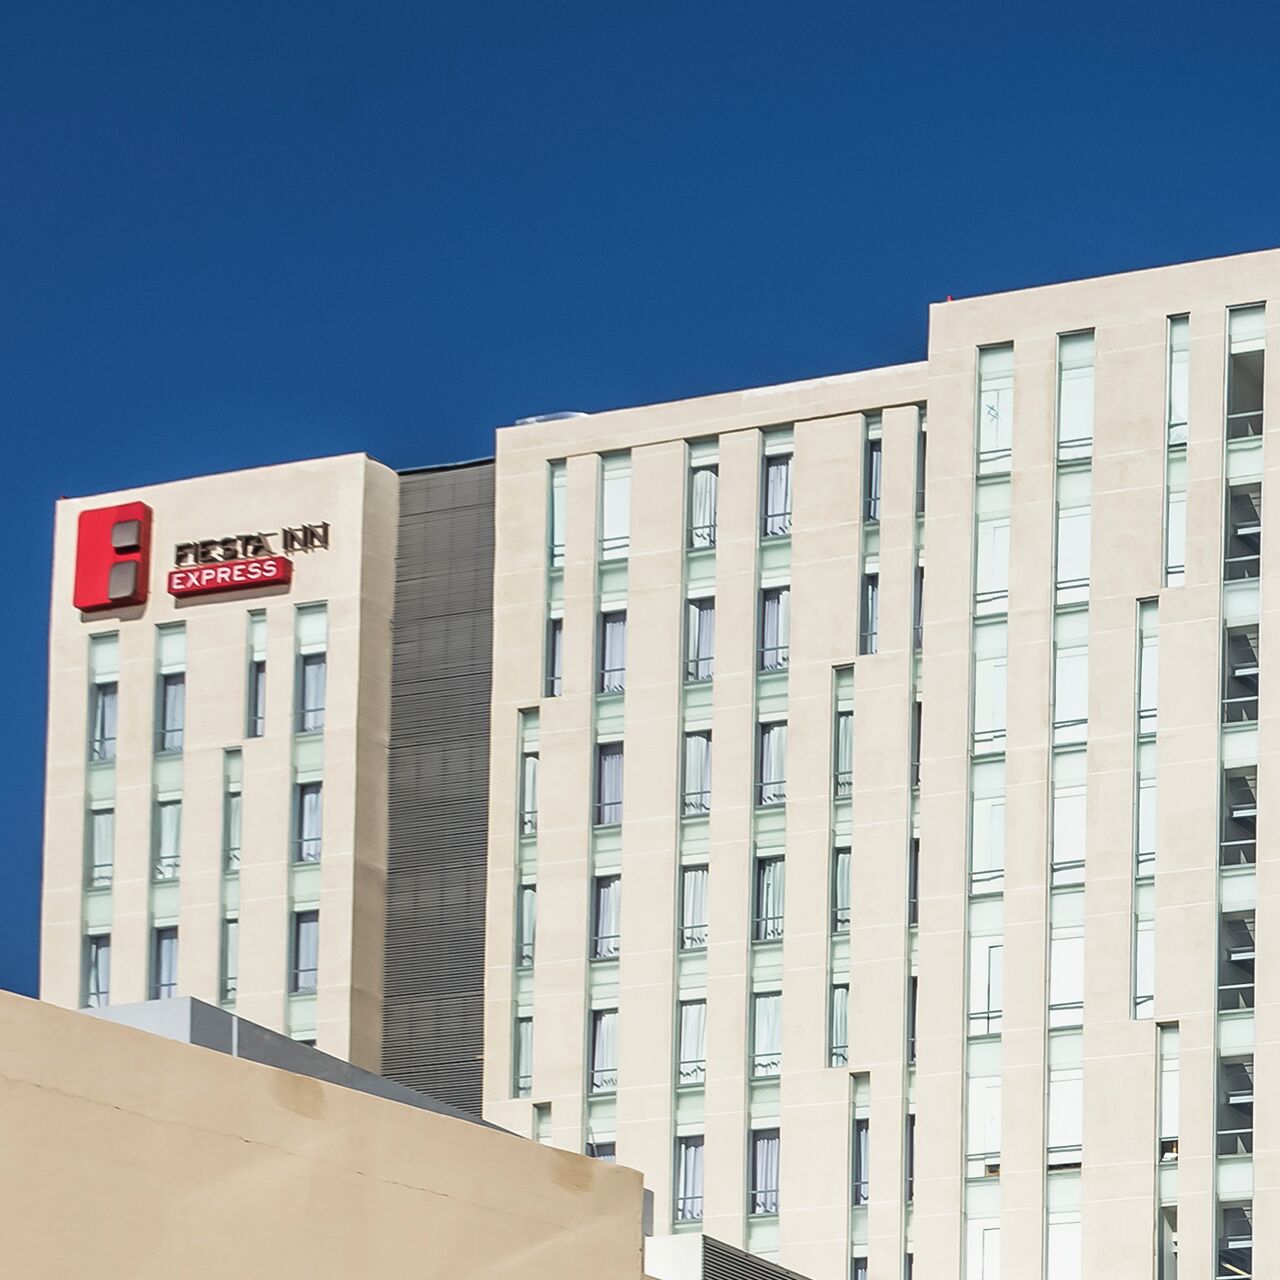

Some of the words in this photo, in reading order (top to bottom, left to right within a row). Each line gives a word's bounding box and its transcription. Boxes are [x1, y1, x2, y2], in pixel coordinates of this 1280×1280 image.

[175, 532, 278, 567] FIESTA
[281, 521, 330, 555] INN
[172, 560, 277, 589] EXPRESS
